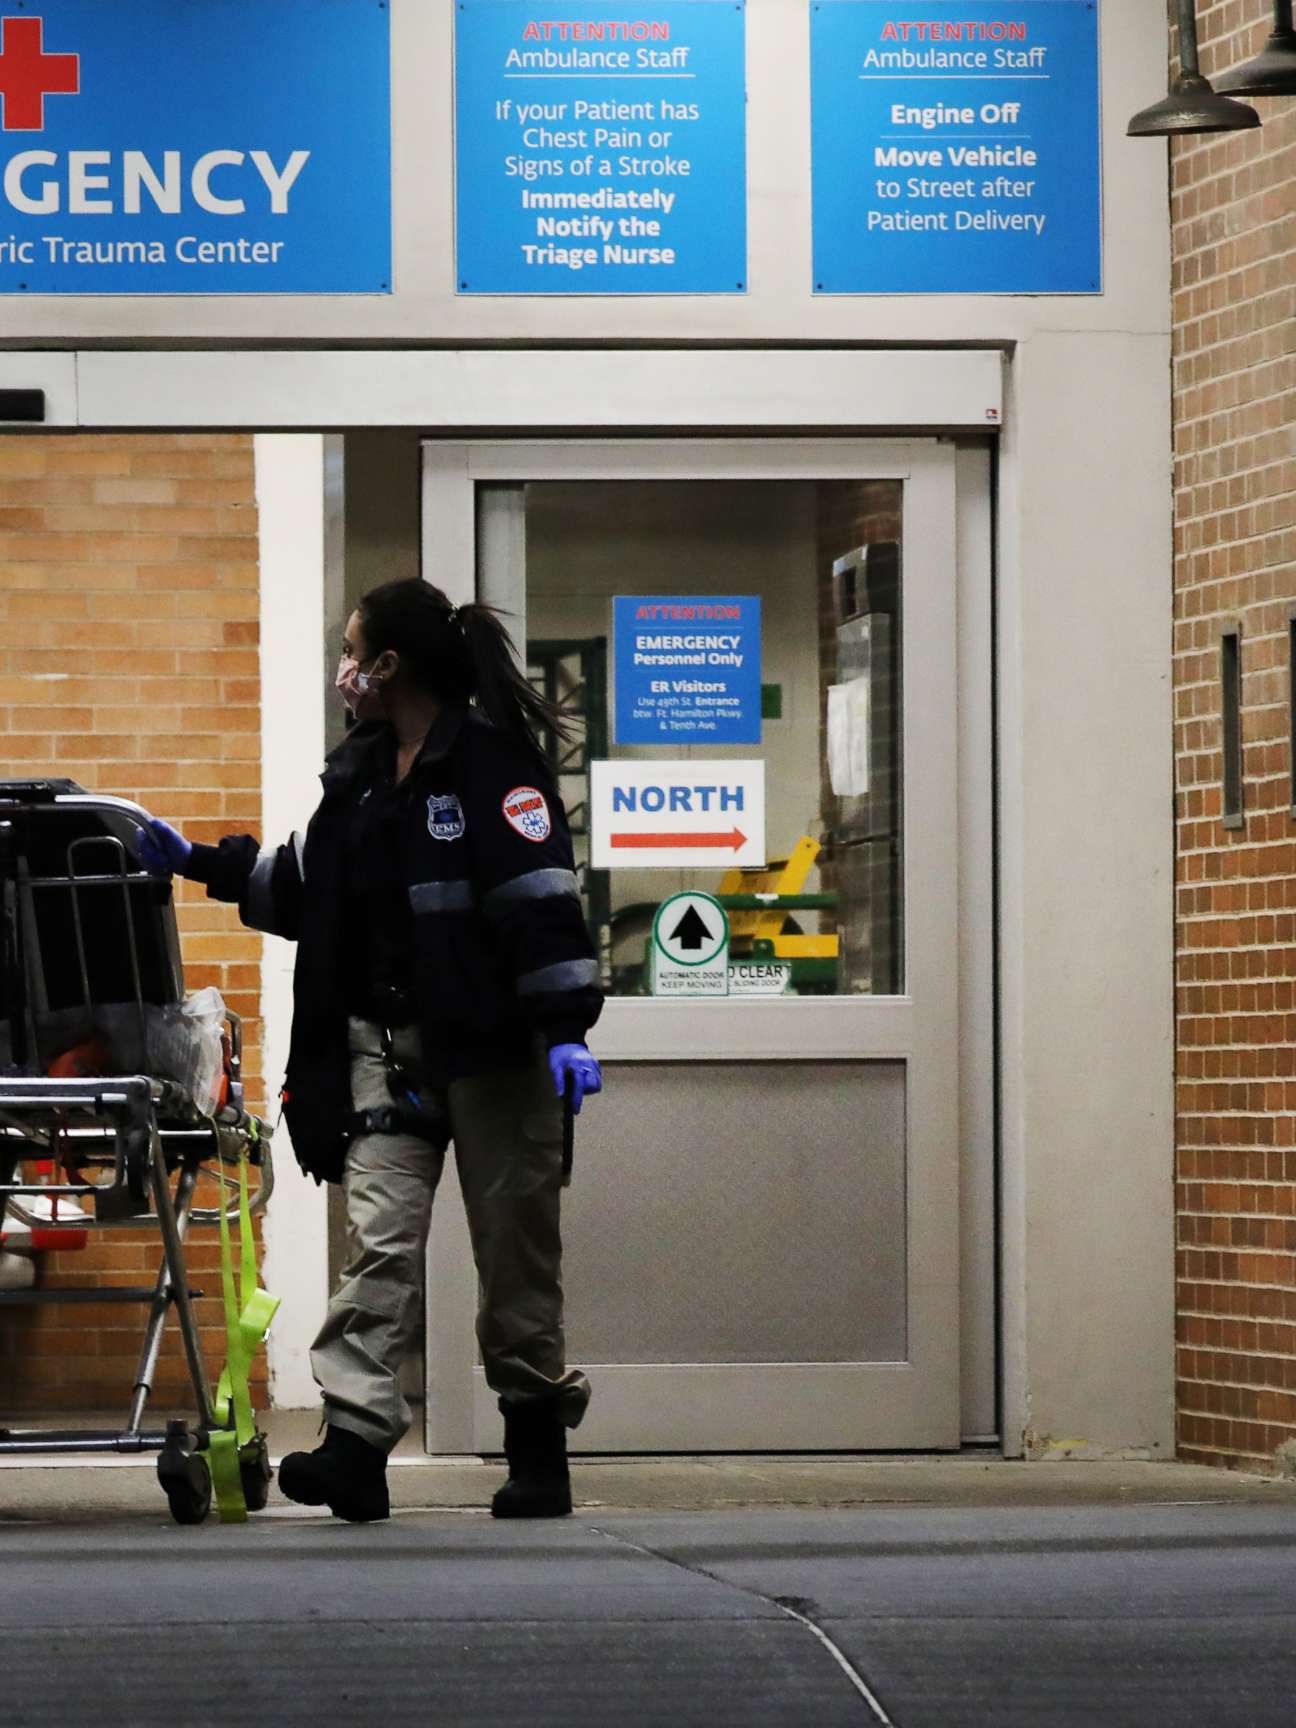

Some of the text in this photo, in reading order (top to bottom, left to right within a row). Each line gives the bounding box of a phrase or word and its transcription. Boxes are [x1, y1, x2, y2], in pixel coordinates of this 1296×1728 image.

[523, 21, 670, 41] ATTENTION
[880, 21, 1026, 41] ATTENTION
[506, 46, 690, 68] Ambulance Staff
[863, 47, 1046, 68] Ambulance Staff
[496, 99, 699, 124] If your Patient has
[891, 103, 1020, 128] Engine Off
[523, 128, 672, 148] Chest Pain or
[875, 145, 1036, 166] Move Vehicle
[506, 155, 690, 181] Signs of a Stroke
[876, 177, 1035, 198] to Street after
[523, 187, 675, 213] Immediately
[537, 215, 660, 239] Notify the
[868, 210, 1045, 234] Patient Delivery
[42, 237, 165, 263] Trauma
[176, 237, 284, 263] Center
[522, 243, 675, 269] Triage Nurse
[635, 605, 741, 619] ATTENTION
[635, 636, 741, 649] EMERGENCY
[633, 652, 744, 667] Personnel Only
[650, 680, 727, 692] ER Visitors
[695, 697, 740, 707] Entrance
[671, 709, 714, 719] Hamilton
[660, 721, 667, 731] &
[669, 721, 696, 731] Tenth
[613, 786, 744, 812] NORTH
[738, 965, 784, 978] CLEAR
